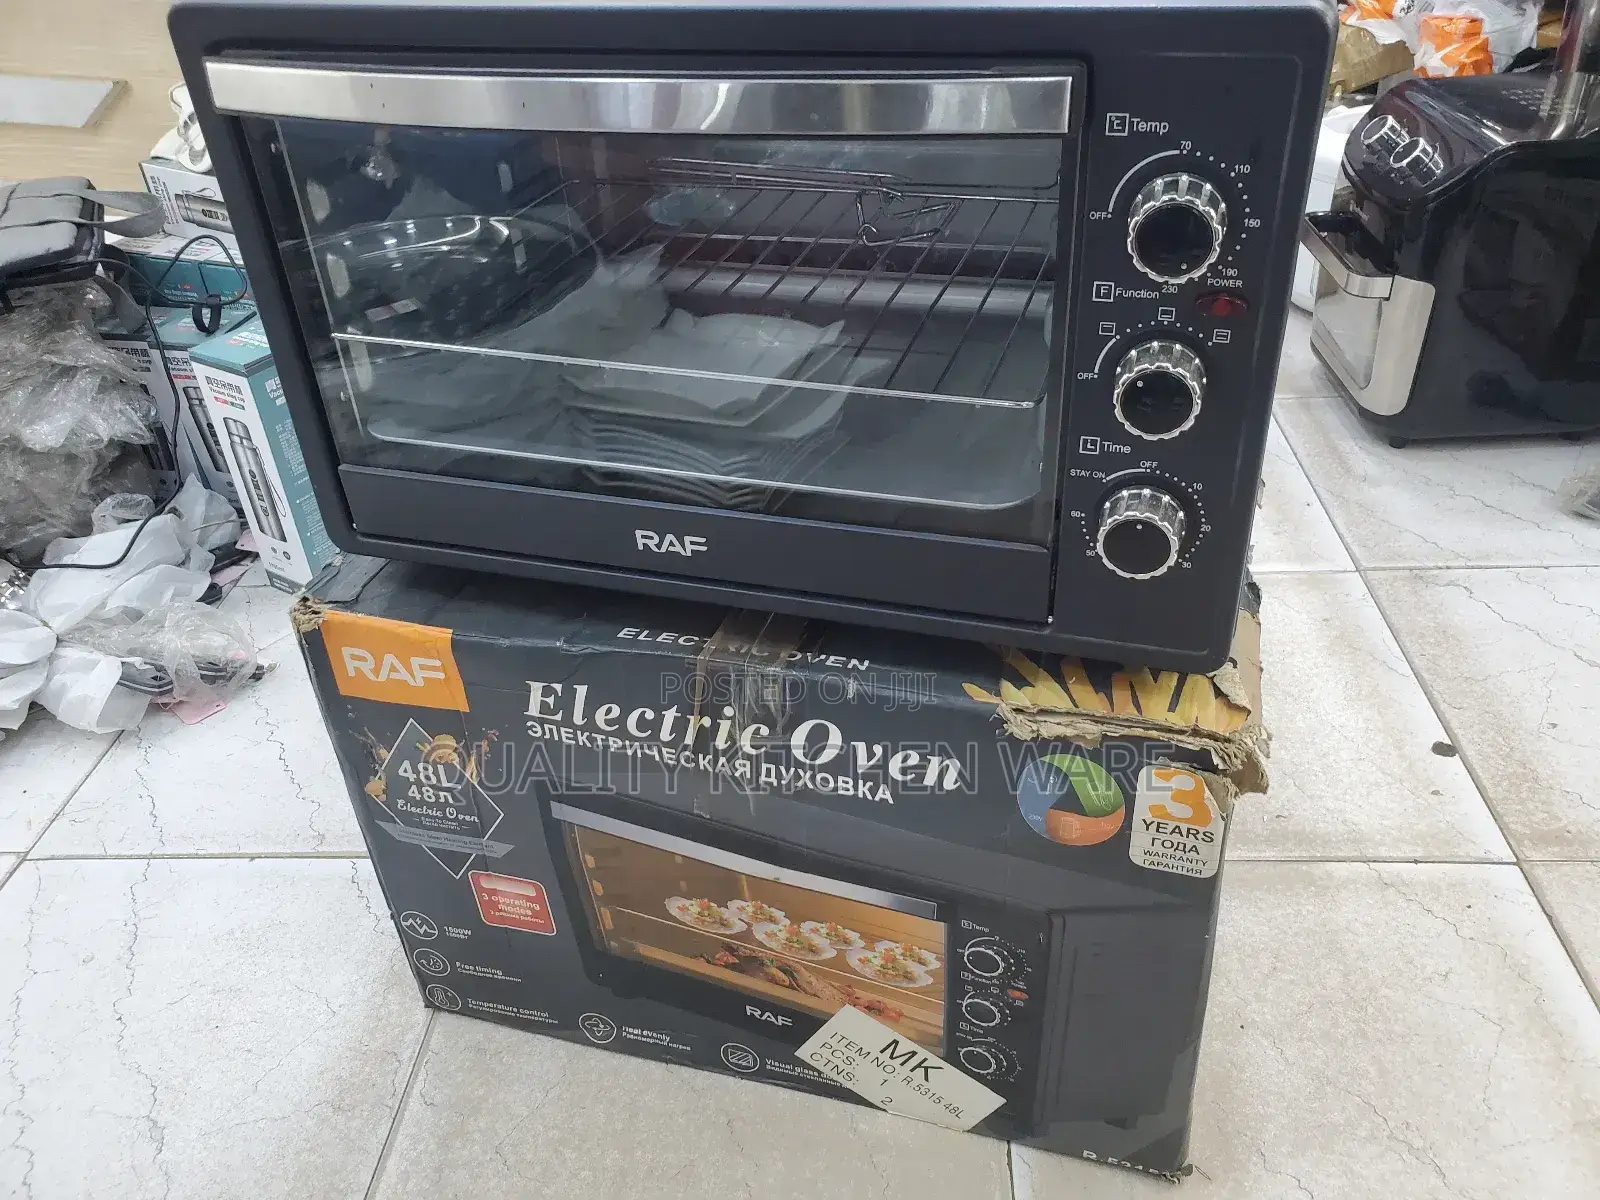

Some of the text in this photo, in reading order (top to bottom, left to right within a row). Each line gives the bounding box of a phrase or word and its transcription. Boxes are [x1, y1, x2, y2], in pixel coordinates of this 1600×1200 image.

[1131, 118, 1170, 136] Temp
[1180, 141, 1192, 150] 70
[1234, 164, 1251, 174] 110
[1089, 211, 1107, 220] OFF
[1243, 218, 1261, 228] 150
[1221, 268, 1238, 277] 190
[1161, 284, 1178, 294] 230
[1207, 278, 1243, 288] POWER
[1116, 287, 1160, 300] Function
[1077, 372, 1094, 380] OFF
[1101, 441, 1132, 454] Time
[1140, 460, 1158, 469] OFF
[1069, 468, 1106, 479] STAY ON
[1192, 482, 1203, 491] 10
[1070, 510, 1081, 518] 60
[1200, 524, 1211, 533] 20
[634, 529, 709, 557] RAF
[1085, 549, 1096, 558] 50
[1181, 560, 1192, 570] 30
[341, 646, 446, 687] RAF
[523, 680, 963, 791] Electric Oven
[526, 720, 895, 804] ЭЛЕКТРИЧЕСКАЯ ДУХОВКА
[398, 759, 462, 791] 48L
[1148, 767, 1213, 828] 3
[397, 799, 480, 823] Electric Oven
[1141, 818, 1215, 843] YEARS
[1150, 837, 1200, 855] ГОДА
[1142, 848, 1208, 867] WARRANTY
[1142, 859, 1203, 876] ГАРАНТИЯ
[481, 892, 541, 911] 3 operating
[497, 904, 532, 916] modes
[972, 923, 990, 933] Temp
[455, 961, 503, 976] Free timing
[467, 997, 549, 1018] Temperature control
[745, 1004, 793, 1027] RAF
[642, 1030, 671, 1042] evenly
[765, 1057, 793, 1070] Visual
[795, 1065, 819, 1077] glass
[820, 1042, 889, 1087] PCS: 1
[879, 1038, 945, 1083] MK
[809, 1052, 860, 1085] CTNS:
[880, 1096, 894, 1106] 2
[829, 1031, 964, 1120] ITEM NO: R.5315 48L
